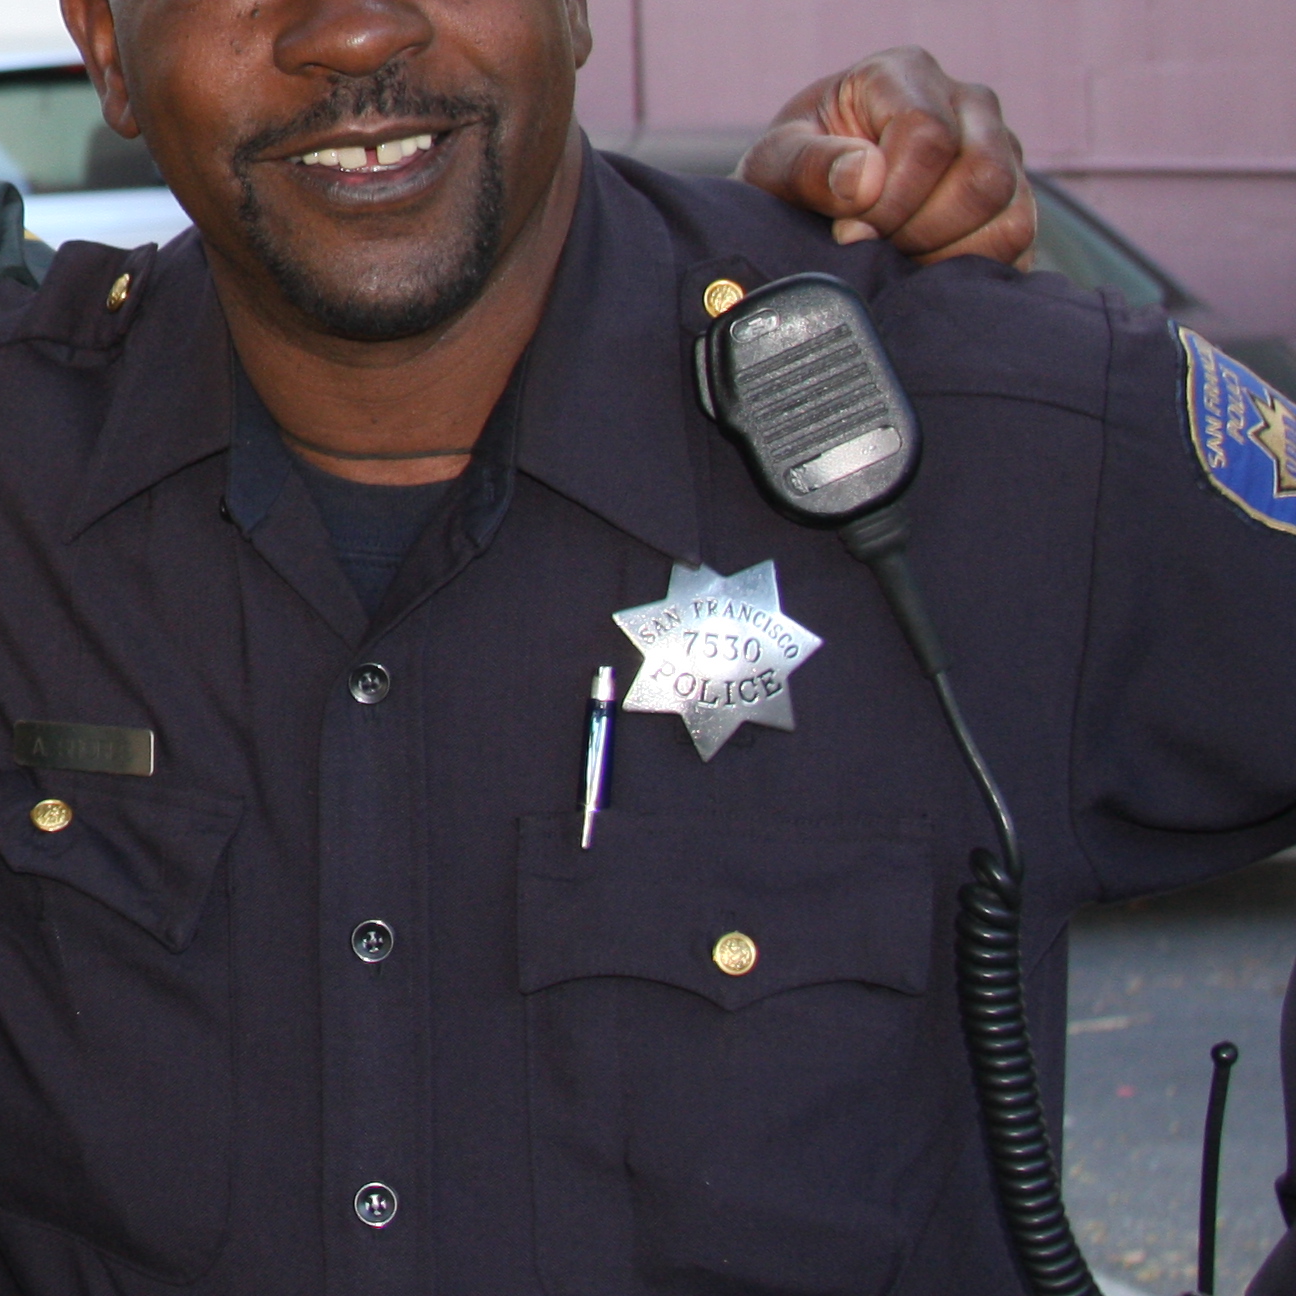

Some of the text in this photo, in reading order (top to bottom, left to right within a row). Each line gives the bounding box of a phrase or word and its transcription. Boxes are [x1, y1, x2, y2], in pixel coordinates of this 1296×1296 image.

[1205, 415, 1226, 468] SAN
[639, 600, 799, 659] SAN FRANCISCO
[683, 631, 761, 664] 7530
[651, 661, 782, 705] POLICE
